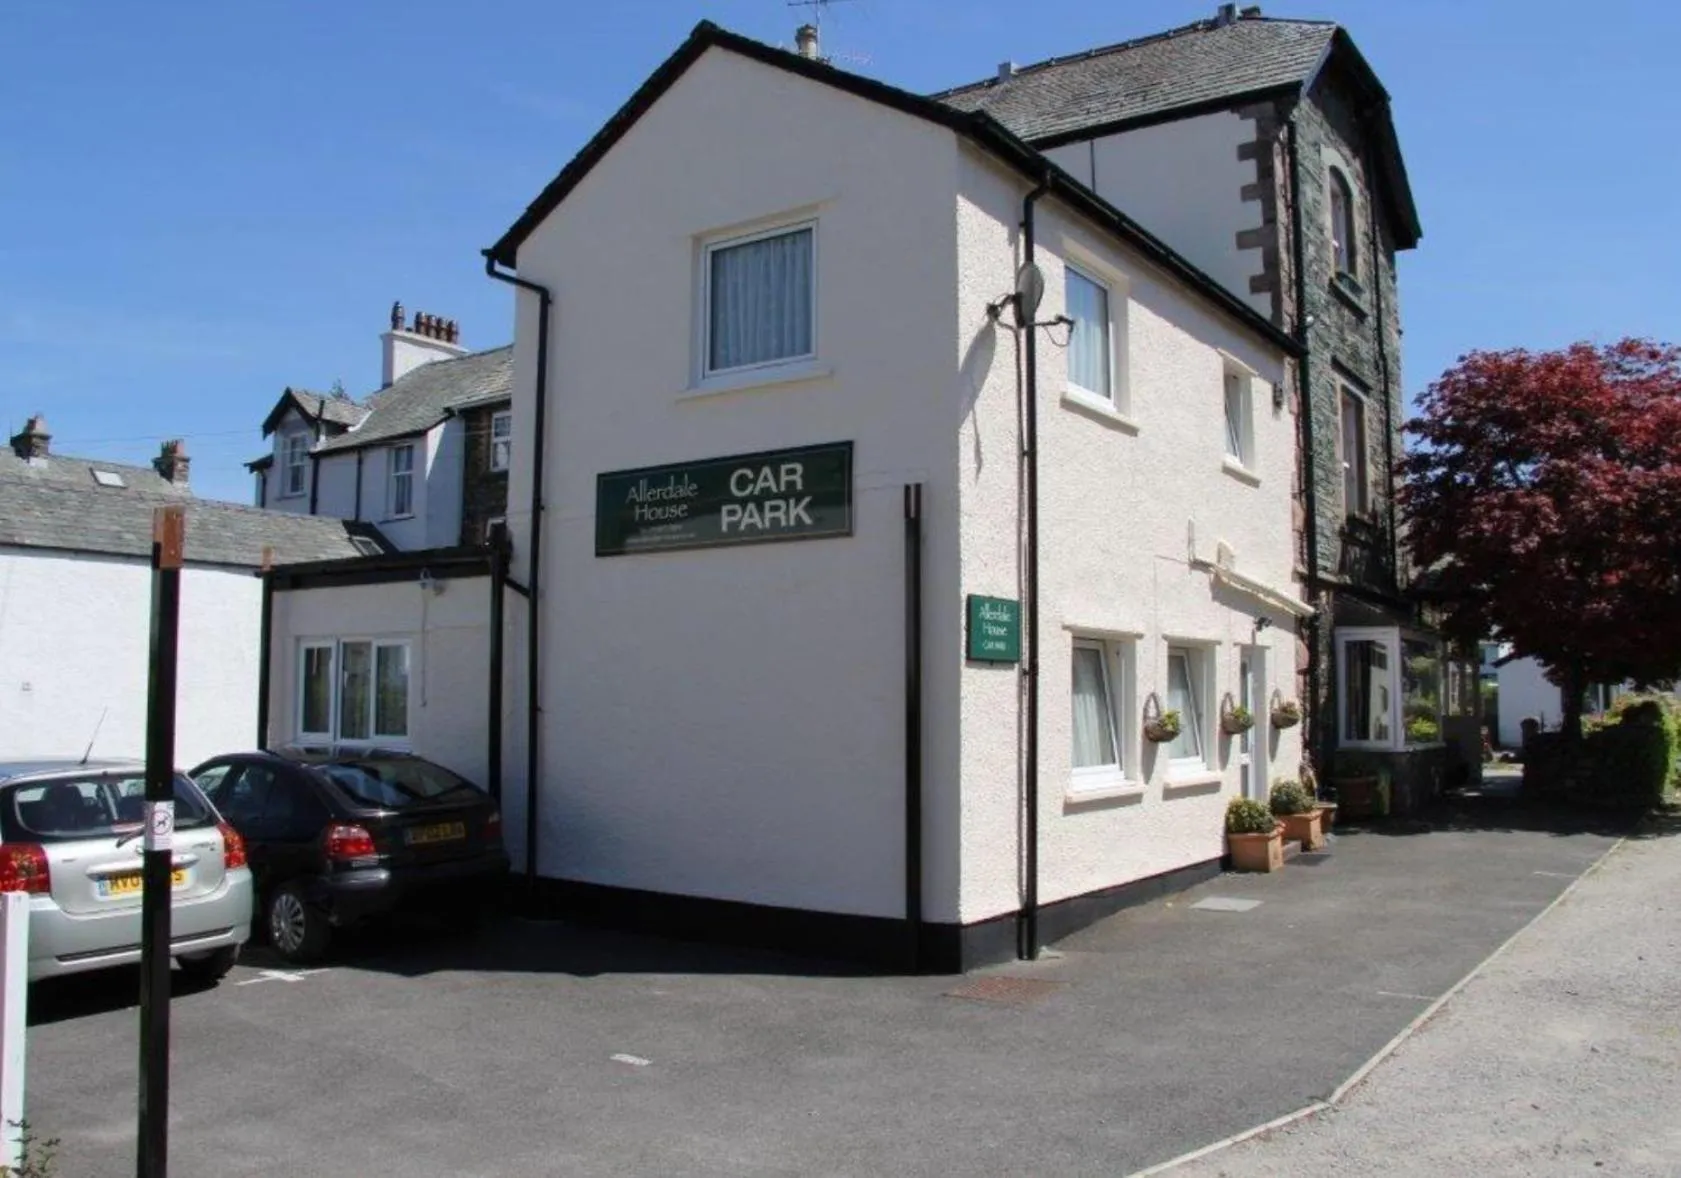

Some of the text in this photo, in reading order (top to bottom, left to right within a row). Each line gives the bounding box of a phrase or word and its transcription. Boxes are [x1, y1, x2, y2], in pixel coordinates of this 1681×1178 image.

[626, 473, 699, 504] Allerdale
[730, 462, 804, 498] CAR
[634, 501, 689, 523] House
[721, 496, 813, 533] PARK
